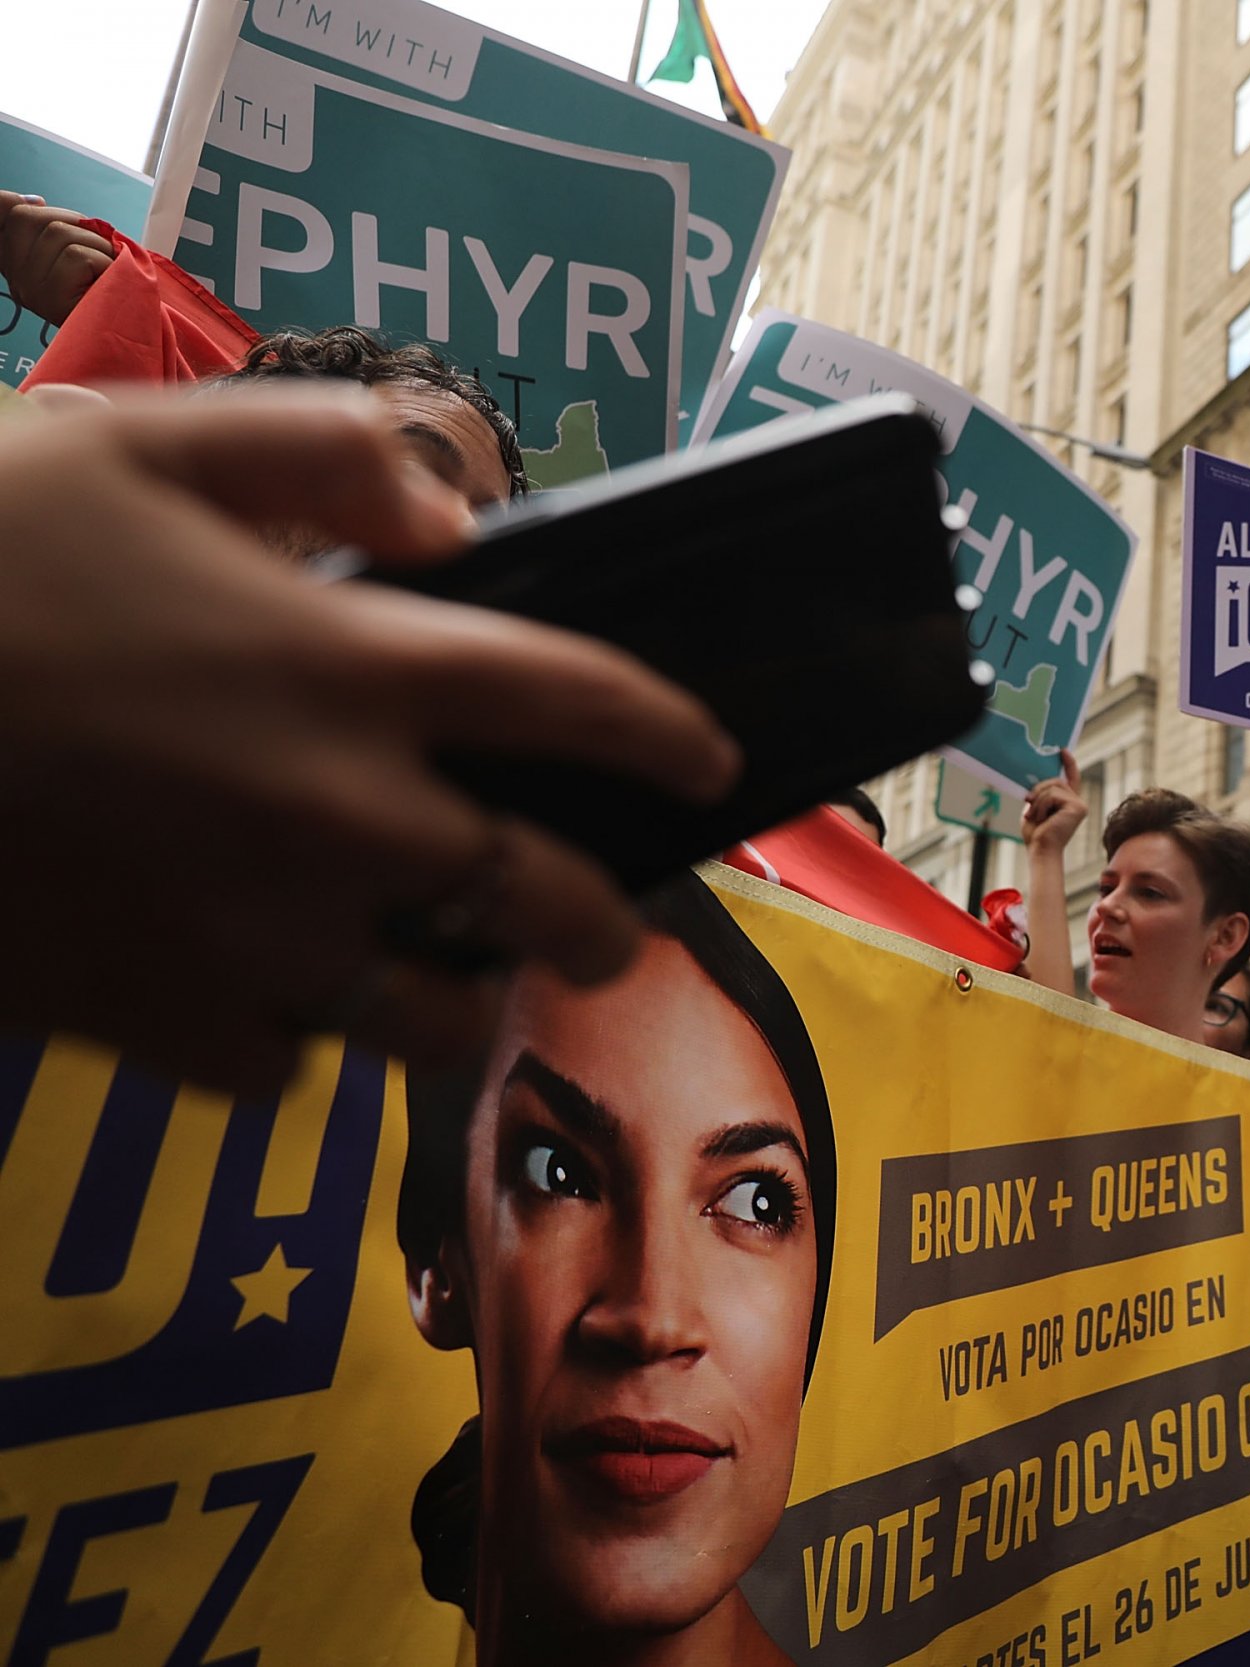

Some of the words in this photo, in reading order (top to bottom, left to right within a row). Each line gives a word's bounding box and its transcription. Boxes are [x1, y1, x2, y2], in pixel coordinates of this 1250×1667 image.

[356, 20, 452, 79] WITH
[935, 467, 1104, 668] HYR
[910, 1176, 1036, 1265] BRONX
[1048, 1180, 1073, 1228] +
[1090, 1147, 1228, 1233] QUEENS
[939, 1332, 1007, 1402] VOTA
[1020, 1313, 1063, 1377] POR
[1075, 1286, 1174, 1357] OCASIO
[1187, 1274, 1226, 1327] EN
[803, 1496, 941, 1650] VOTE
[951, 1456, 1042, 1577] FOR
[1053, 1394, 1225, 1528] OCASIO
[1062, 1604, 1101, 1667] EL
[1114, 1579, 1154, 1646] 26
[1166, 1558, 1201, 1621] DE
